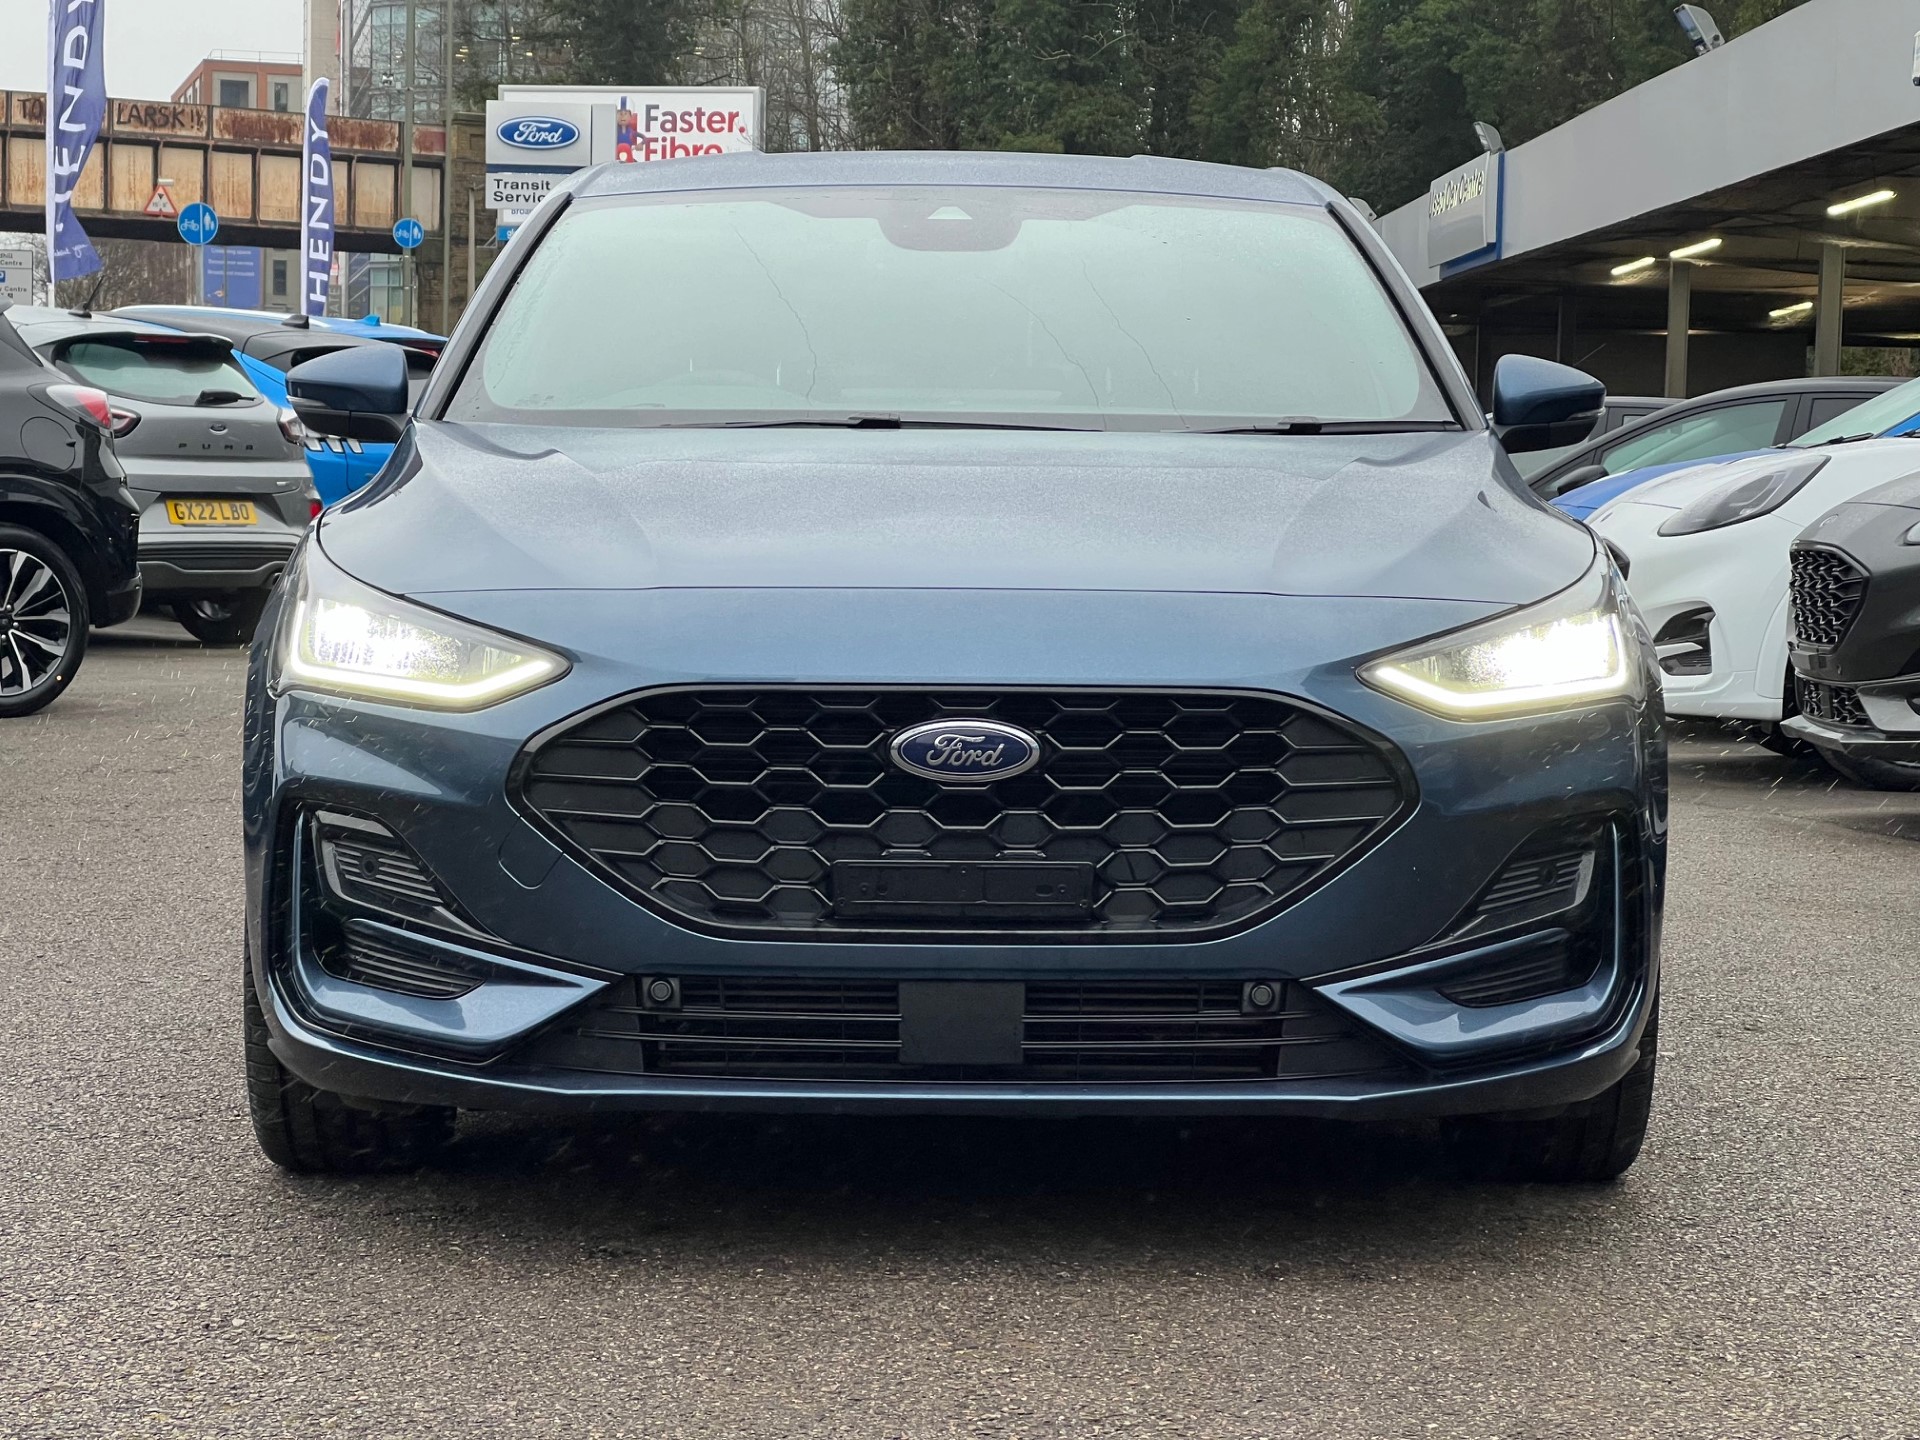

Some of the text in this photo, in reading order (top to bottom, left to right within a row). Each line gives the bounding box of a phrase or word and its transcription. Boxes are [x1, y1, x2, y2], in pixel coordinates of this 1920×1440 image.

[645, 104, 746, 133] Faster.
[513, 121, 563, 143] Ford
[493, 178, 551, 191] Transit
[493, 191, 546, 203] Servic
[309, 117, 330, 303] HENDY
[178, 443, 254, 451] PUMA
[174, 502, 218, 521] GX22
[926, 733, 1005, 766] Ford
